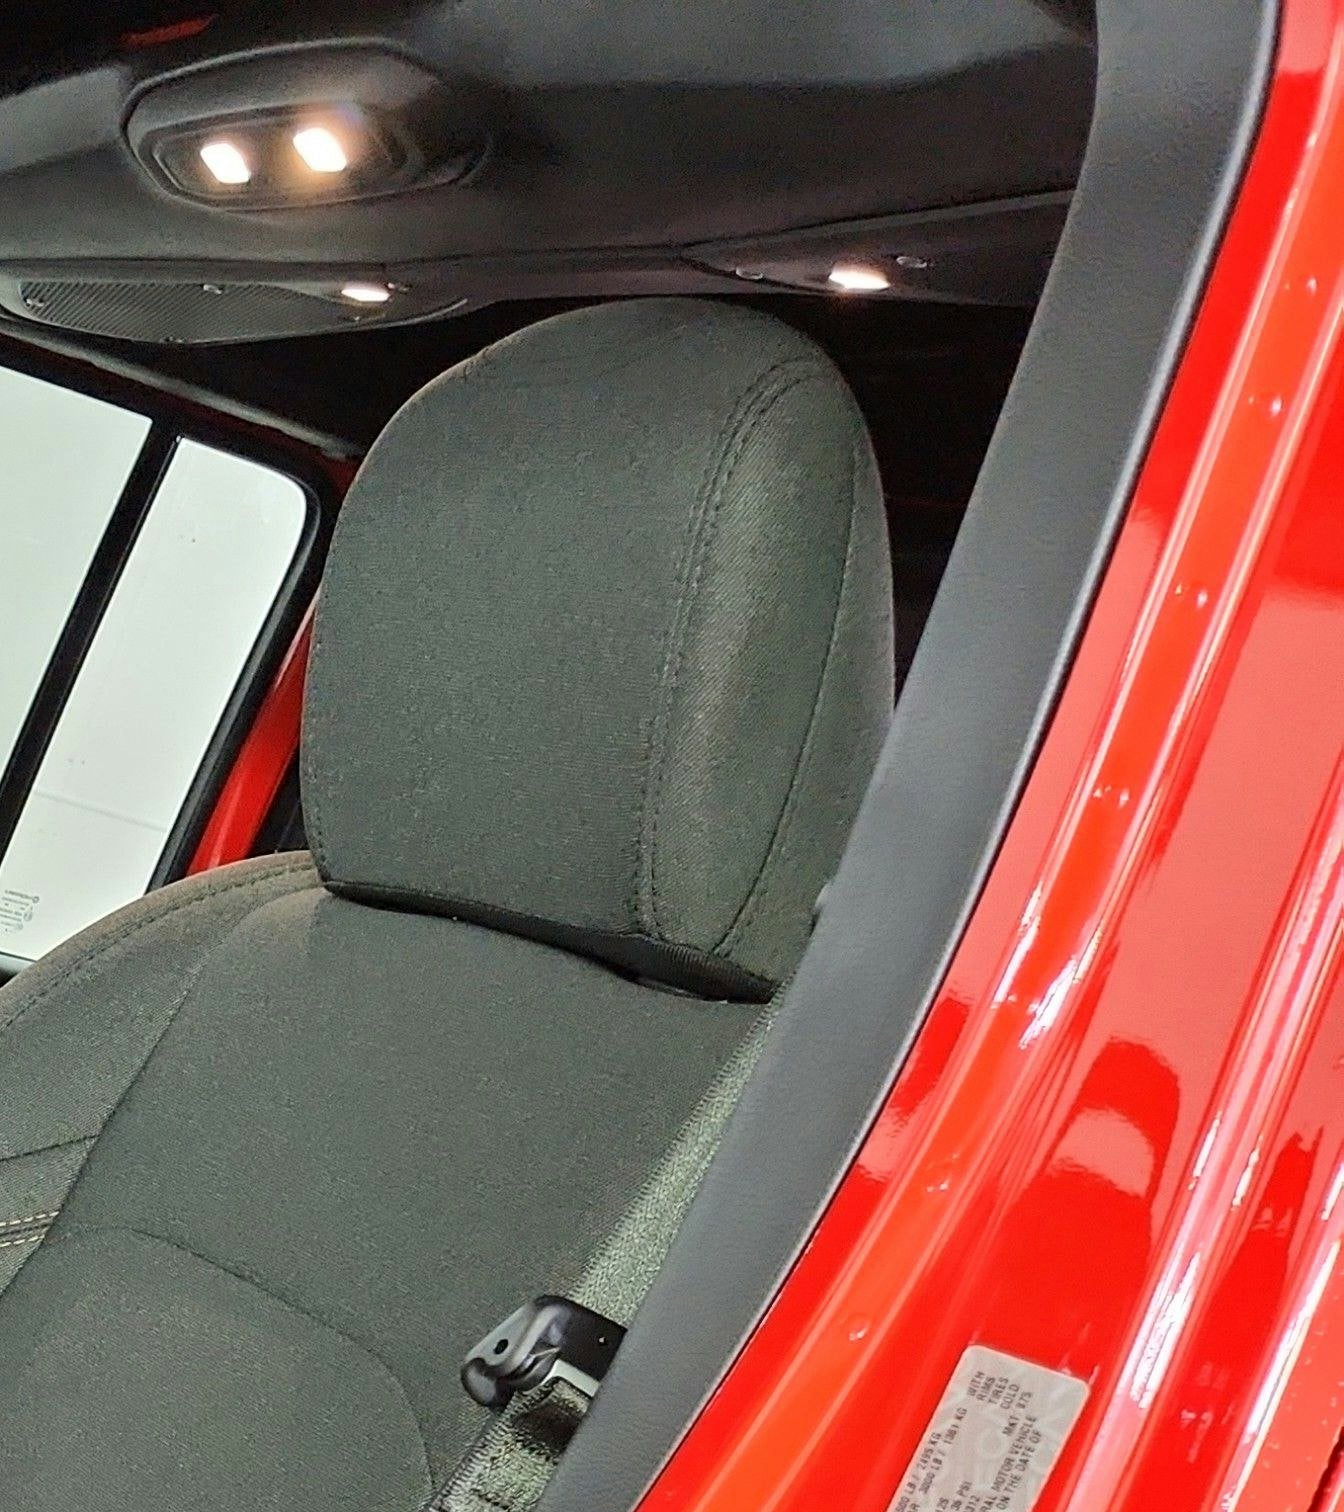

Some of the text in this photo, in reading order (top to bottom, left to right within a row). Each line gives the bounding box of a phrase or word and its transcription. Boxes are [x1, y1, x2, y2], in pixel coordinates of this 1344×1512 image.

[953, 1405, 968, 1422] KG
[965, 1369, 986, 1397] WITH
[976, 1374, 996, 1402] RIMS
[987, 1375, 1010, 1406] TIRES
[999, 1382, 1020, 1410] COLD
[990, 1455, 1016, 1492] MOTOR
[1008, 1413, 1037, 1457] VEHICLE
[995, 1493, 1011, 1511] ON
[1003, 1472, 1021, 1495] THE
[1014, 1443, 1036, 1473] DATE
[1027, 1428, 1043, 1445] OF
